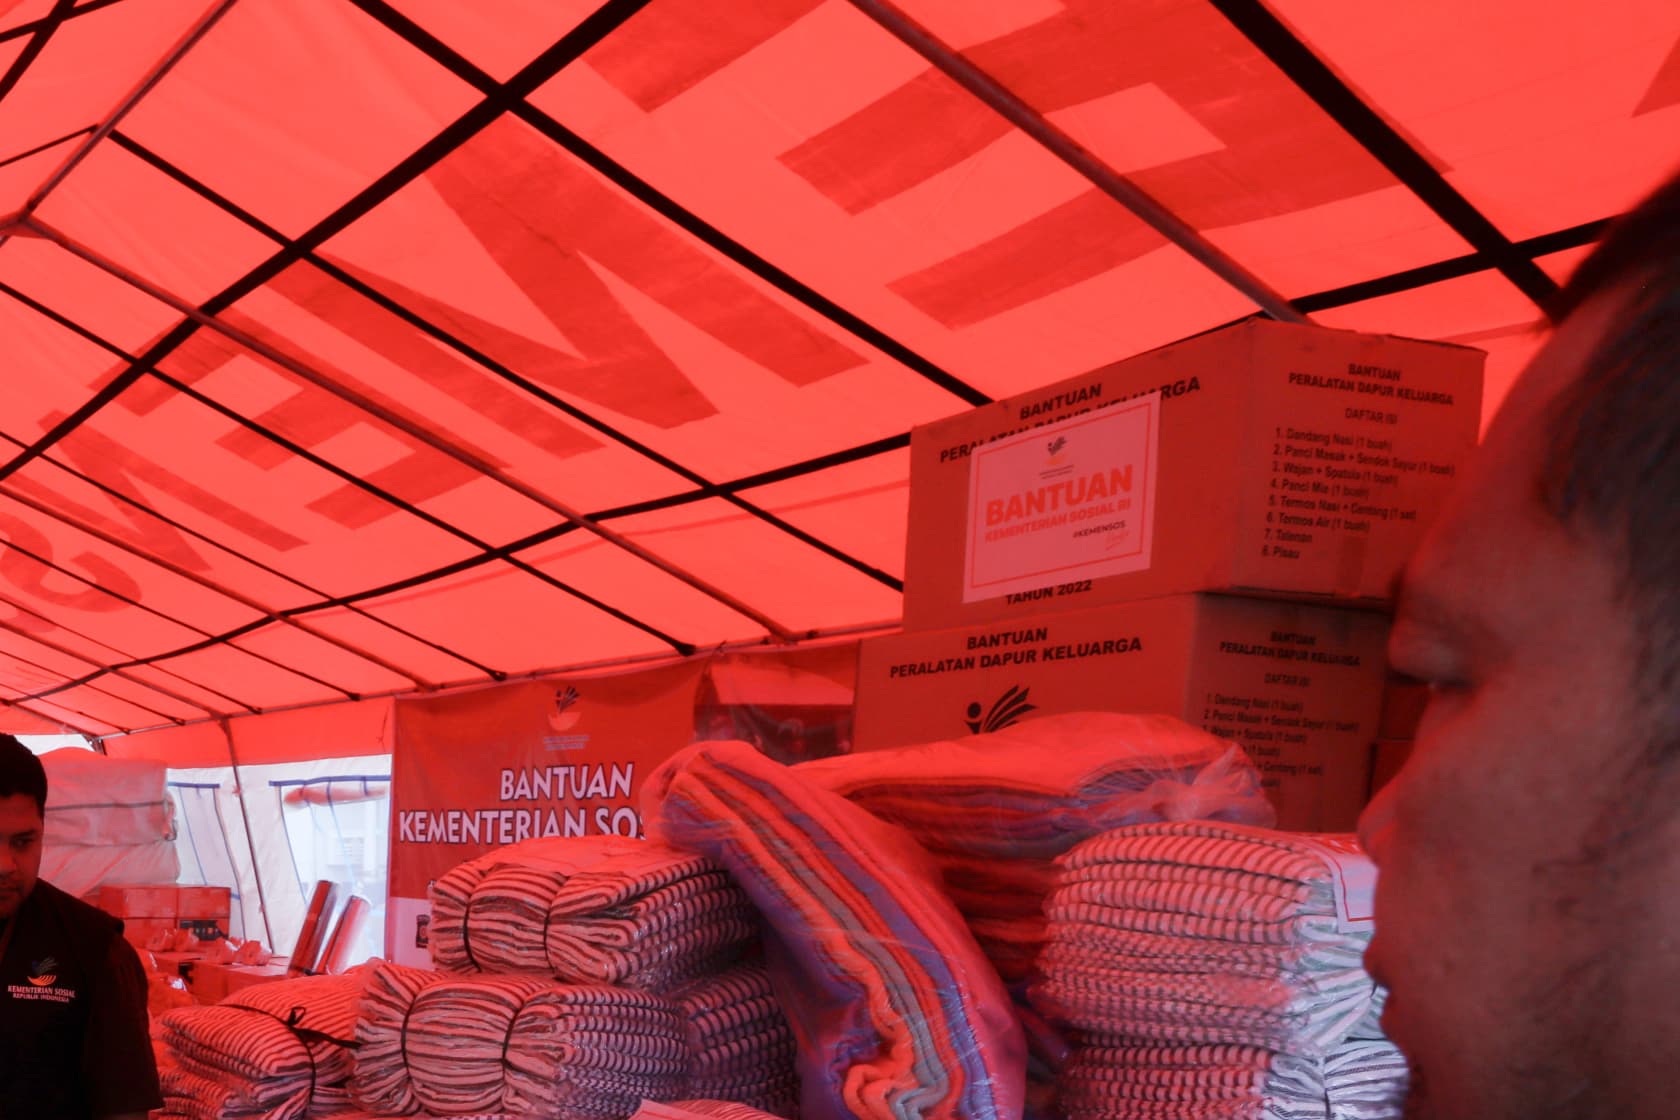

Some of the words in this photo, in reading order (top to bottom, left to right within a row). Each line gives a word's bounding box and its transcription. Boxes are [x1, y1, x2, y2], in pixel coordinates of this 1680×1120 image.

[1289, 372, 1354, 391] PERALATAN
[1358, 382, 1394, 397] DAPUR
[1397, 388, 1453, 405] KELUARGA
[1348, 364, 1400, 381] BANTUAN
[1019, 383, 1102, 420] BANTUAN
[1345, 408, 1383, 422] DAFTAR
[986, 464, 1133, 527] BANTUAN
[984, 514, 1067, 543] KEMENTERIAN
[1070, 503, 1115, 522] SOSIAL
[1006, 586, 1054, 605] TAHUN
[1057, 580, 1092, 596] 2022
[890, 657, 975, 678] PERALATAN
[980, 648, 1037, 669] DAPUR
[1042, 637, 1143, 662] KELUARGA
[967, 628, 1048, 650] BANTUAN
[500, 763, 634, 801] BANTUAN
[399, 807, 586, 844] KEMENTERIAN
